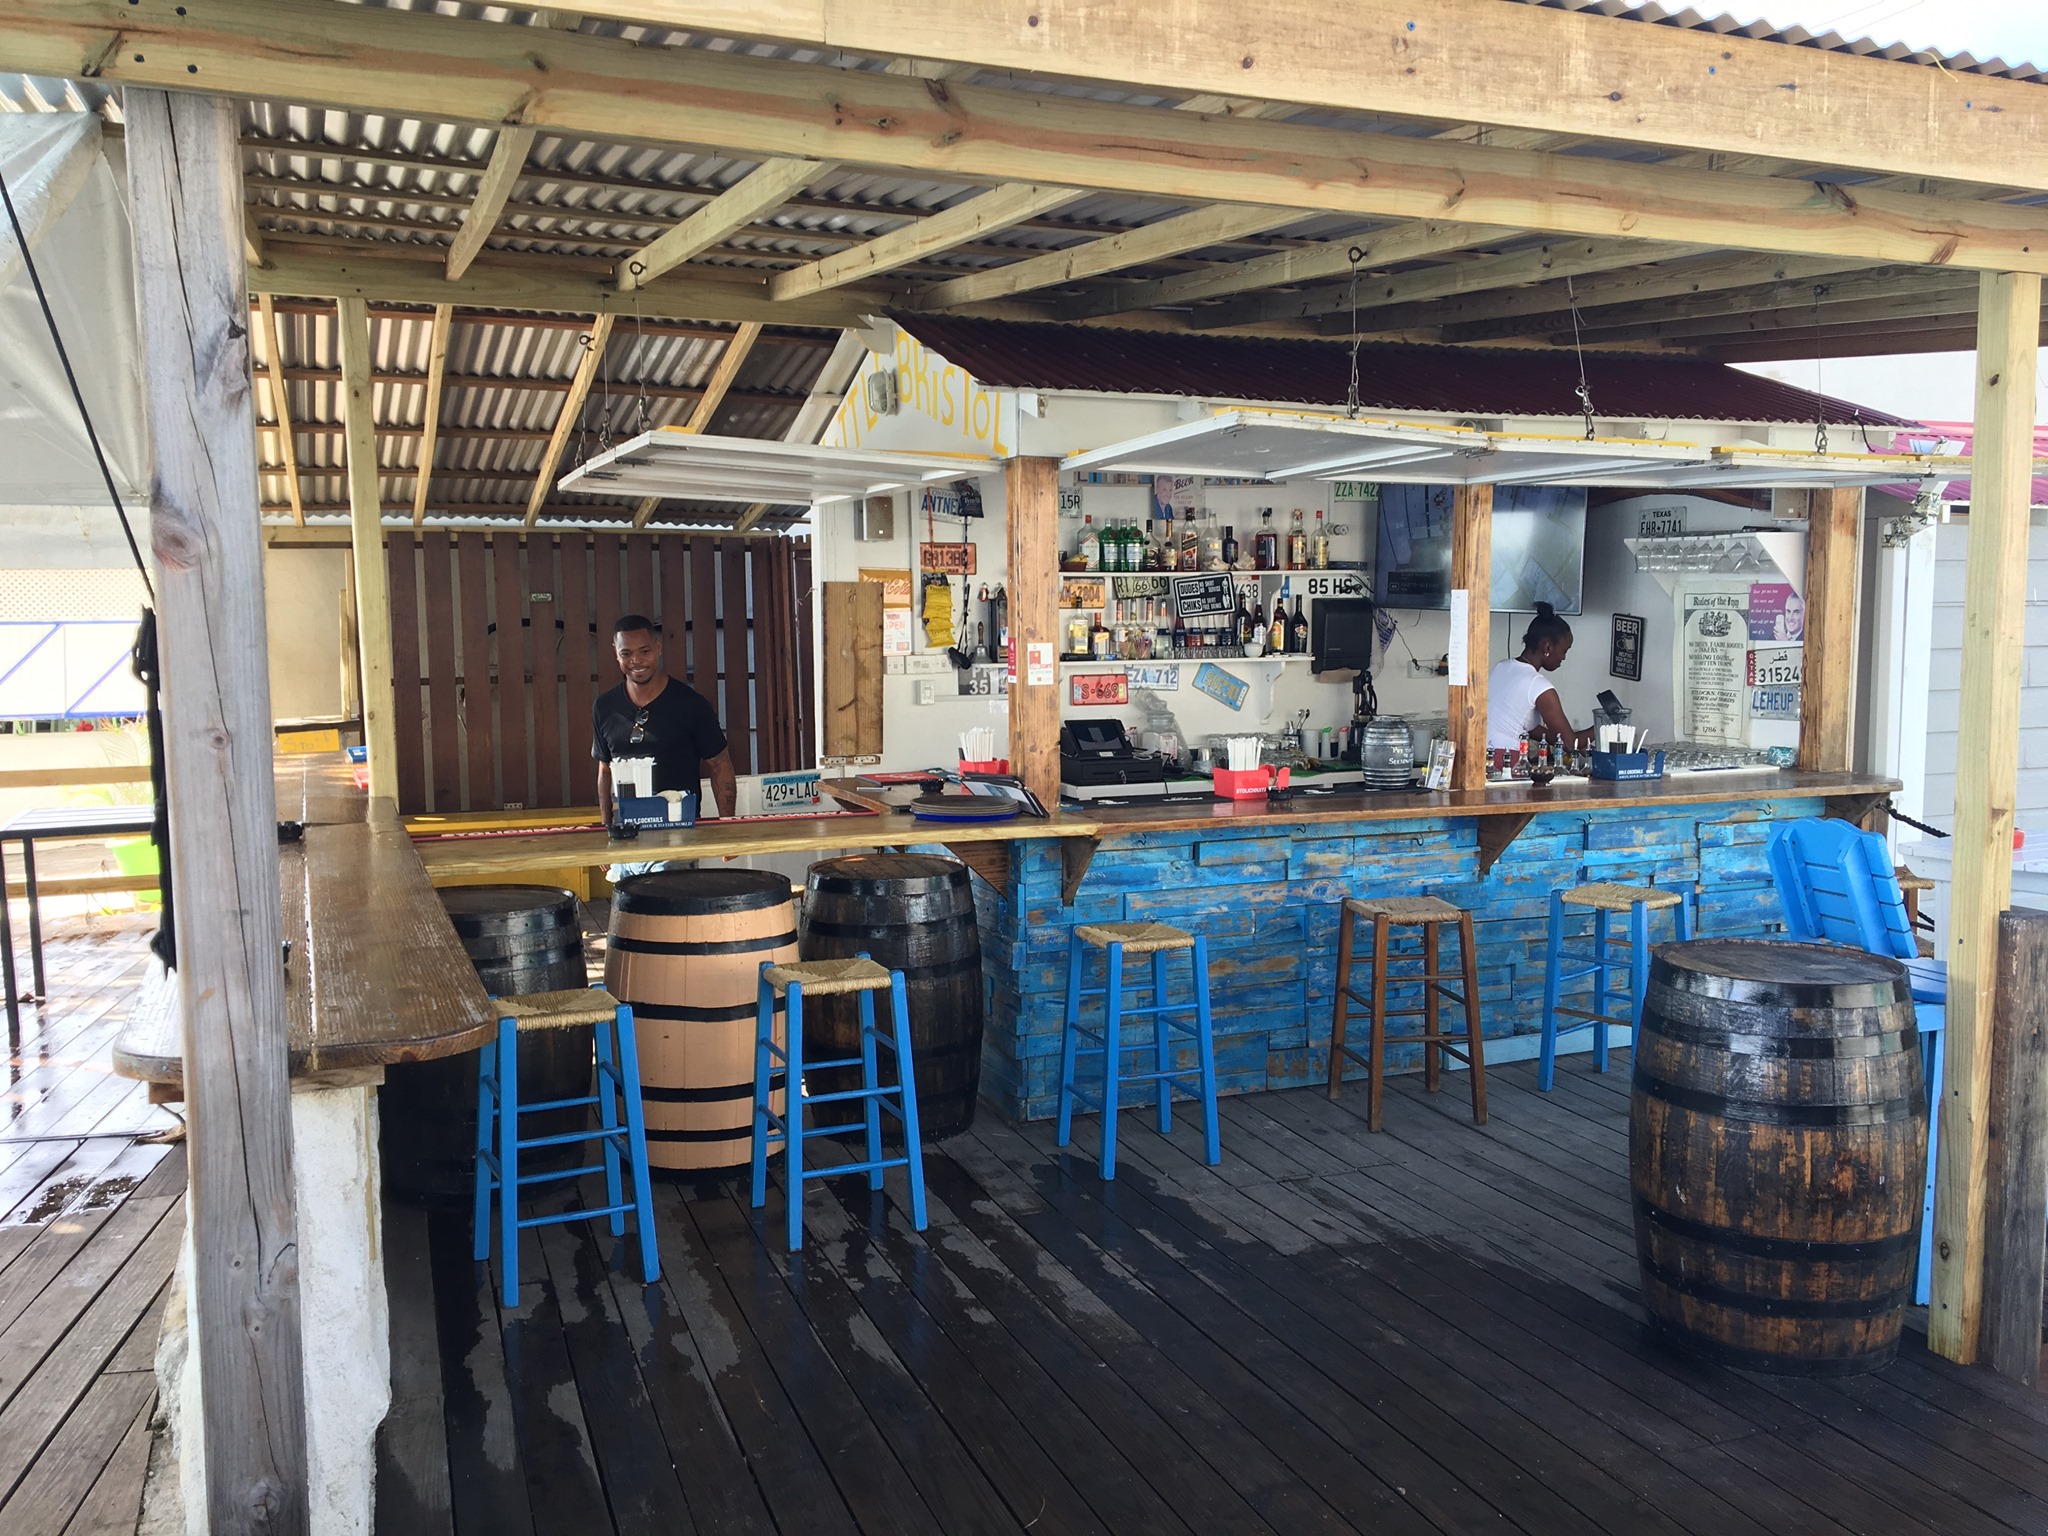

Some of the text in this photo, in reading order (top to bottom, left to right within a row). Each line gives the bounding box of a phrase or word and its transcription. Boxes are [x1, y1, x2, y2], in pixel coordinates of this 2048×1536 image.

[896, 330, 1008, 459] BRISTOL
[921, 495, 961, 516] ANTNE
[1652, 510, 1672, 518] TEXAS
[1135, 581, 1148, 591] 66
[1180, 582, 1200, 595] DUDES
[1308, 578, 1329, 594] 85
[1693, 596, 1711, 606] Rules
[1711, 597, 1717, 607] of
[1717, 596, 1727, 606] the
[1616, 619, 1638, 635] BEER
[1156, 669, 1177, 684] 712
[969, 680, 989, 695] 35
[765, 781, 819, 801] 429 LAC
[637, 816, 663, 826] COCKTAILS
